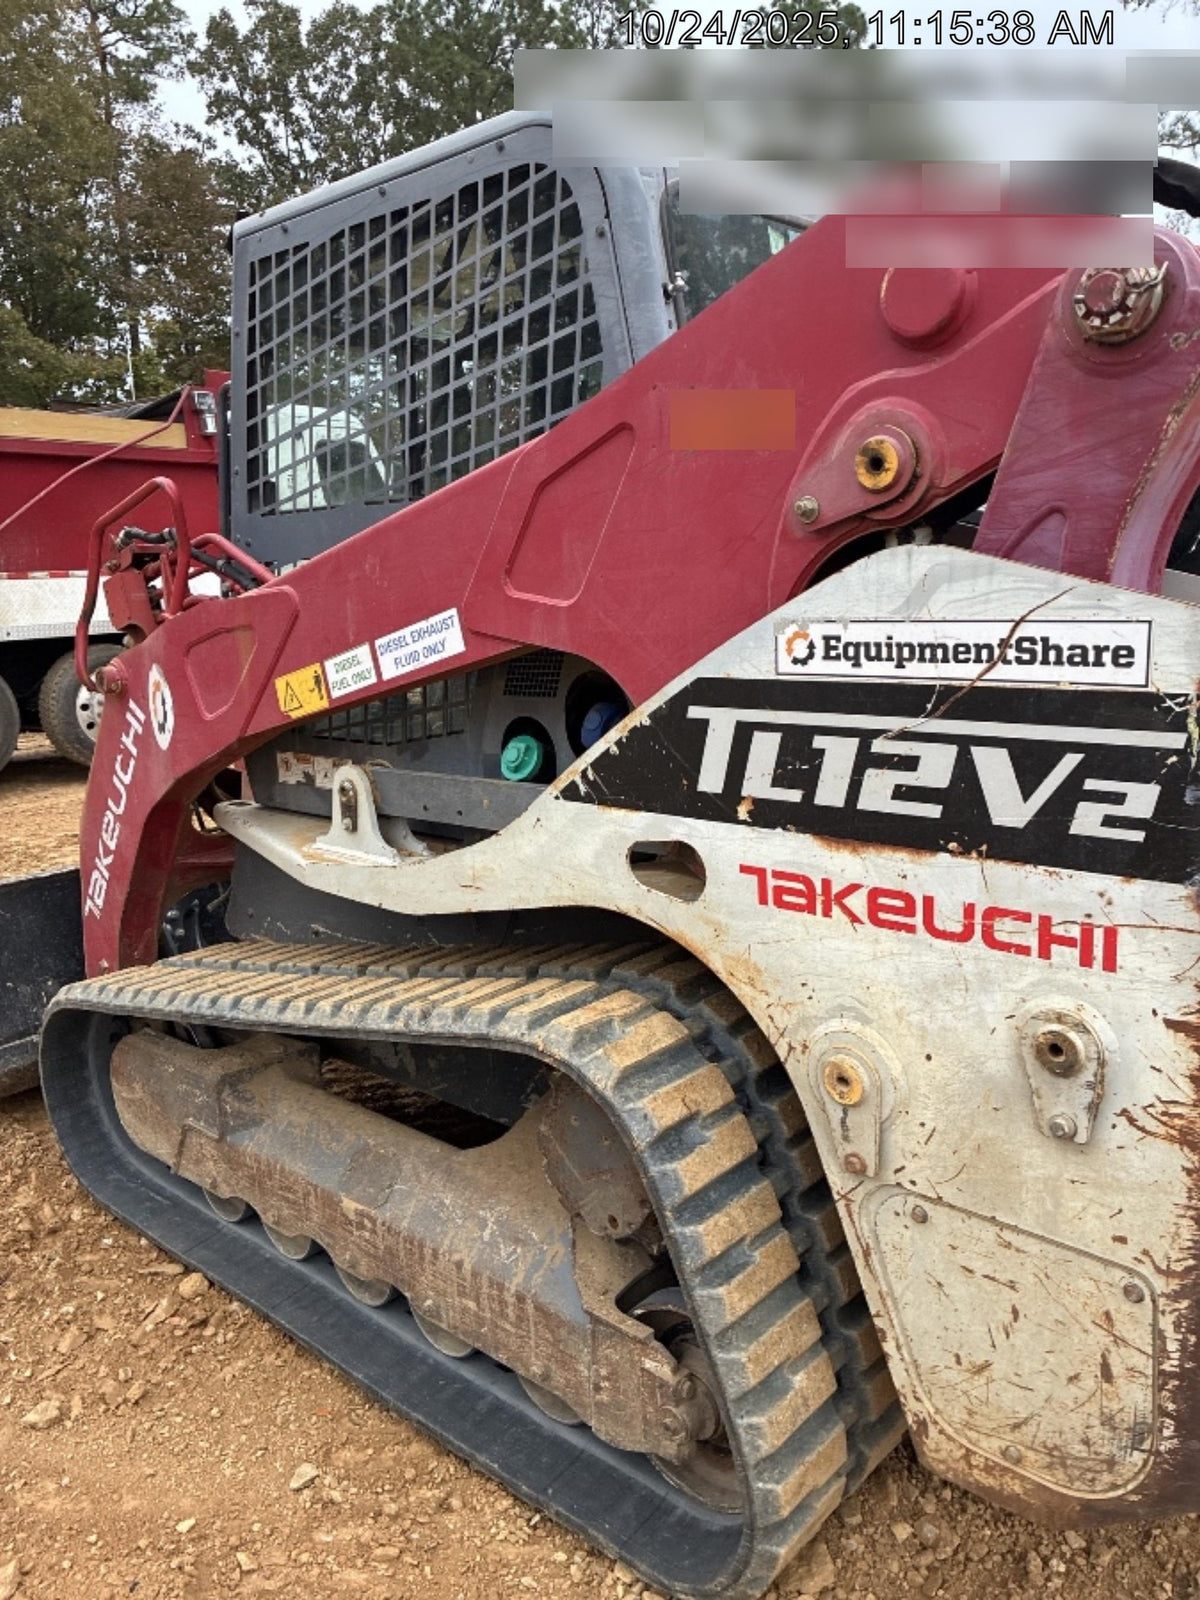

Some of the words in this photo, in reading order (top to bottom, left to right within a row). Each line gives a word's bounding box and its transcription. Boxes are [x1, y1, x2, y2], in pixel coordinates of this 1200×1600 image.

[378, 634, 410, 656] DIESEL
[410, 615, 455, 642] EXHAUST
[821, 634, 1135, 670] EquipmentShare
[333, 653, 362, 674] DIESEL
[394, 650, 420, 670] FLUID
[422, 637, 447, 659] ONLY
[331, 677, 351, 692] FUEL
[351, 667, 373, 685] ONLY
